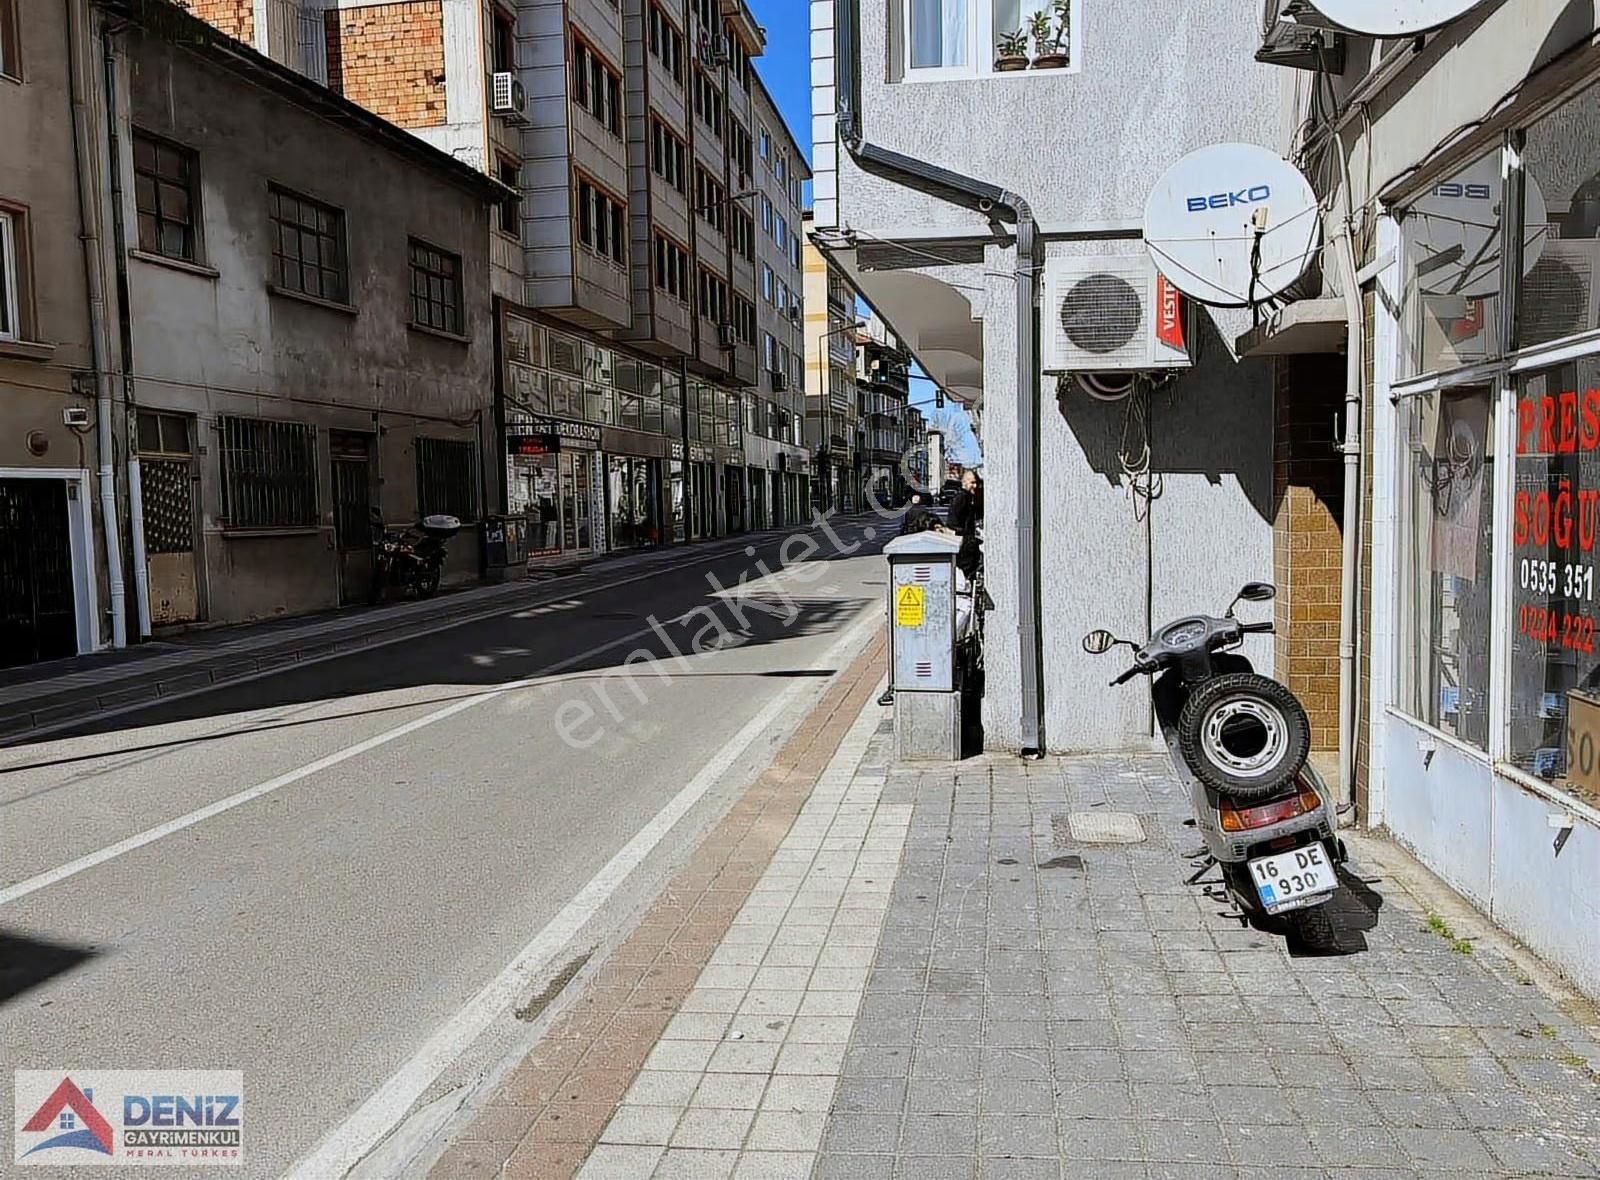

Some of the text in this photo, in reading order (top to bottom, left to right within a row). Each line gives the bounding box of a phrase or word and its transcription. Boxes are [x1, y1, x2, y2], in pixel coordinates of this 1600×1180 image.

[1186, 185, 1271, 212] BEKO
[1516, 389, 1600, 455] PRES
[1513, 481, 1600, 552] SOĞU
[1520, 559, 1593, 602] 0535 351
[1519, 606, 1595, 653] 0224 222
[1256, 848, 1322, 880] 16 DE
[1279, 872, 1316, 895] 930
